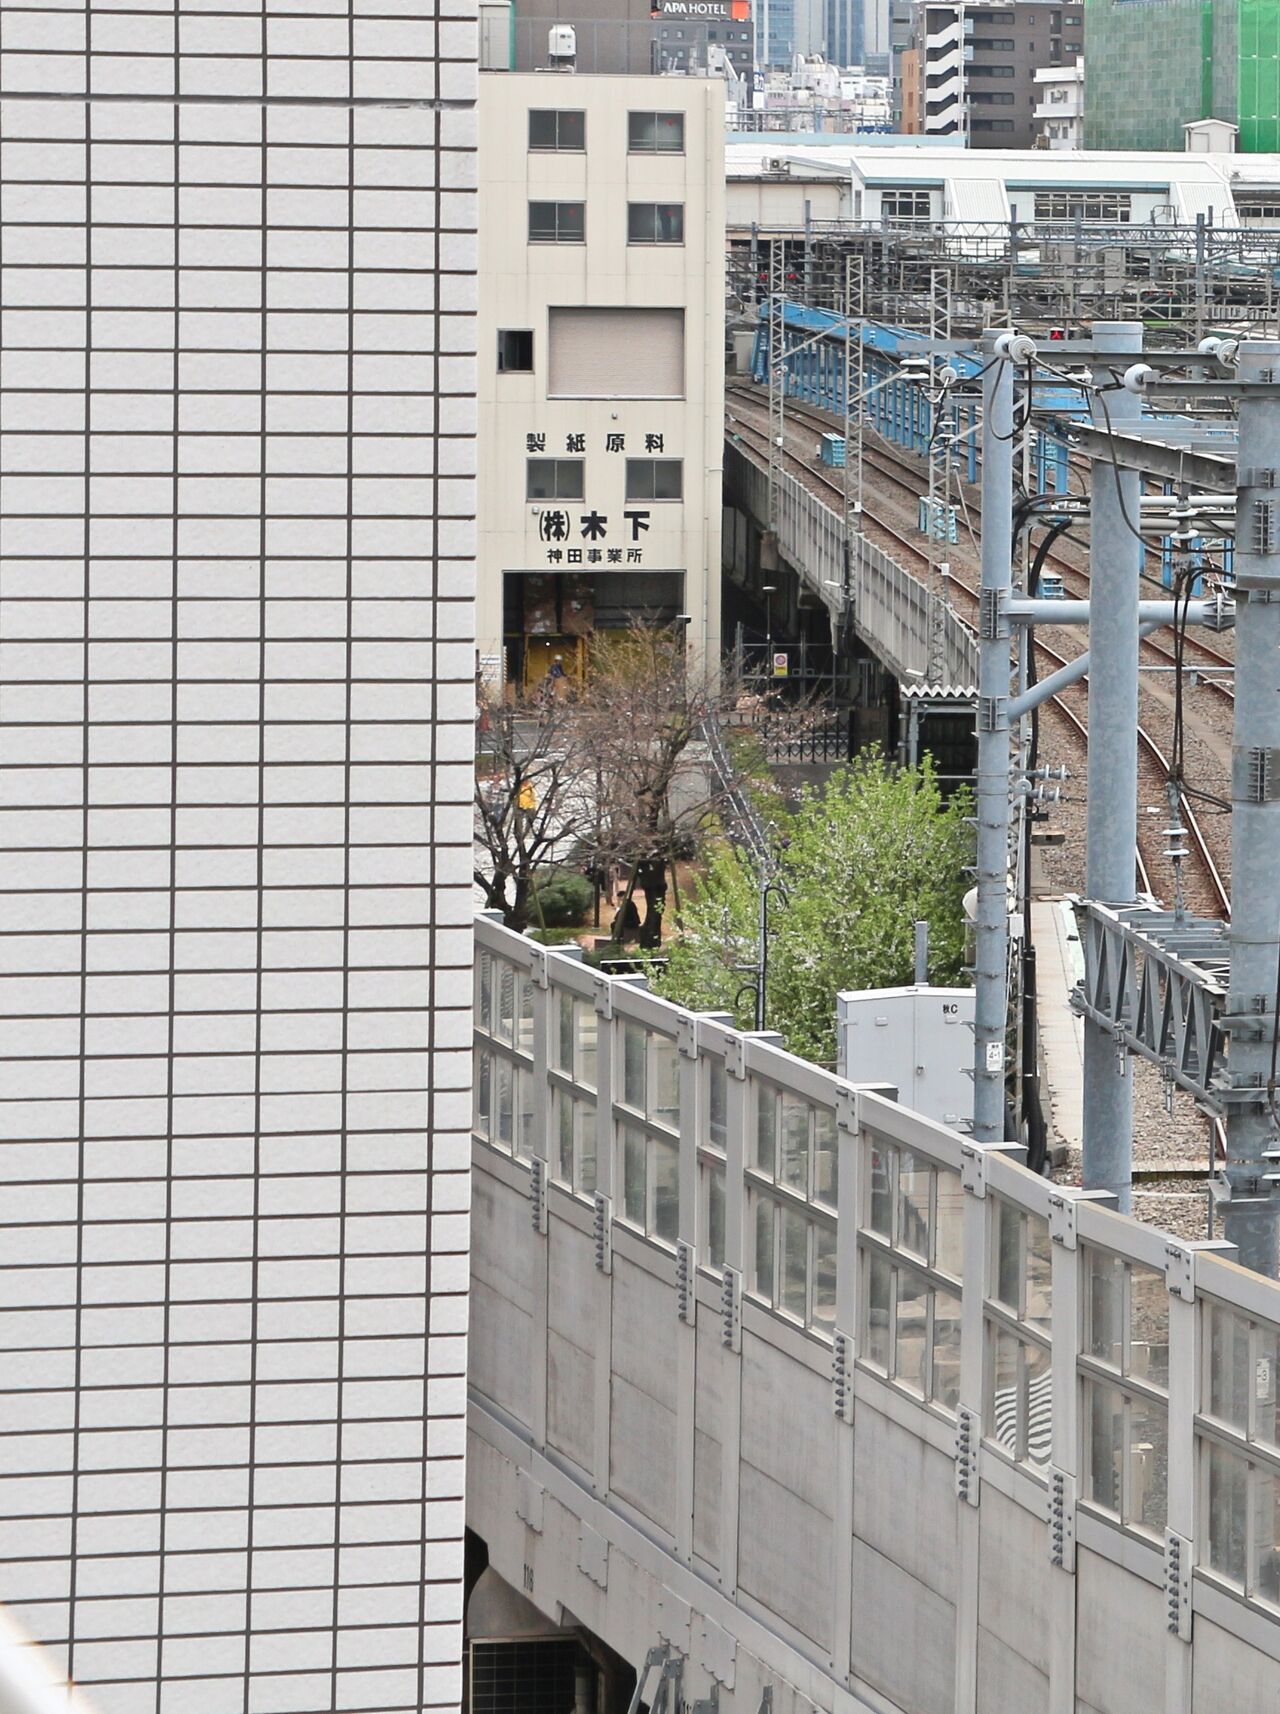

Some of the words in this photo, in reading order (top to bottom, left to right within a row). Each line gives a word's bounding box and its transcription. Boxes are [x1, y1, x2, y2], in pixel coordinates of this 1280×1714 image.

[663, 2, 687, 13] APA
[689, 3, 727, 15] HOTEL
[526, 433, 664, 453] 製紙原料
[539, 510, 650, 541] (株)木下
[547, 548, 642, 563] 神田事業所
